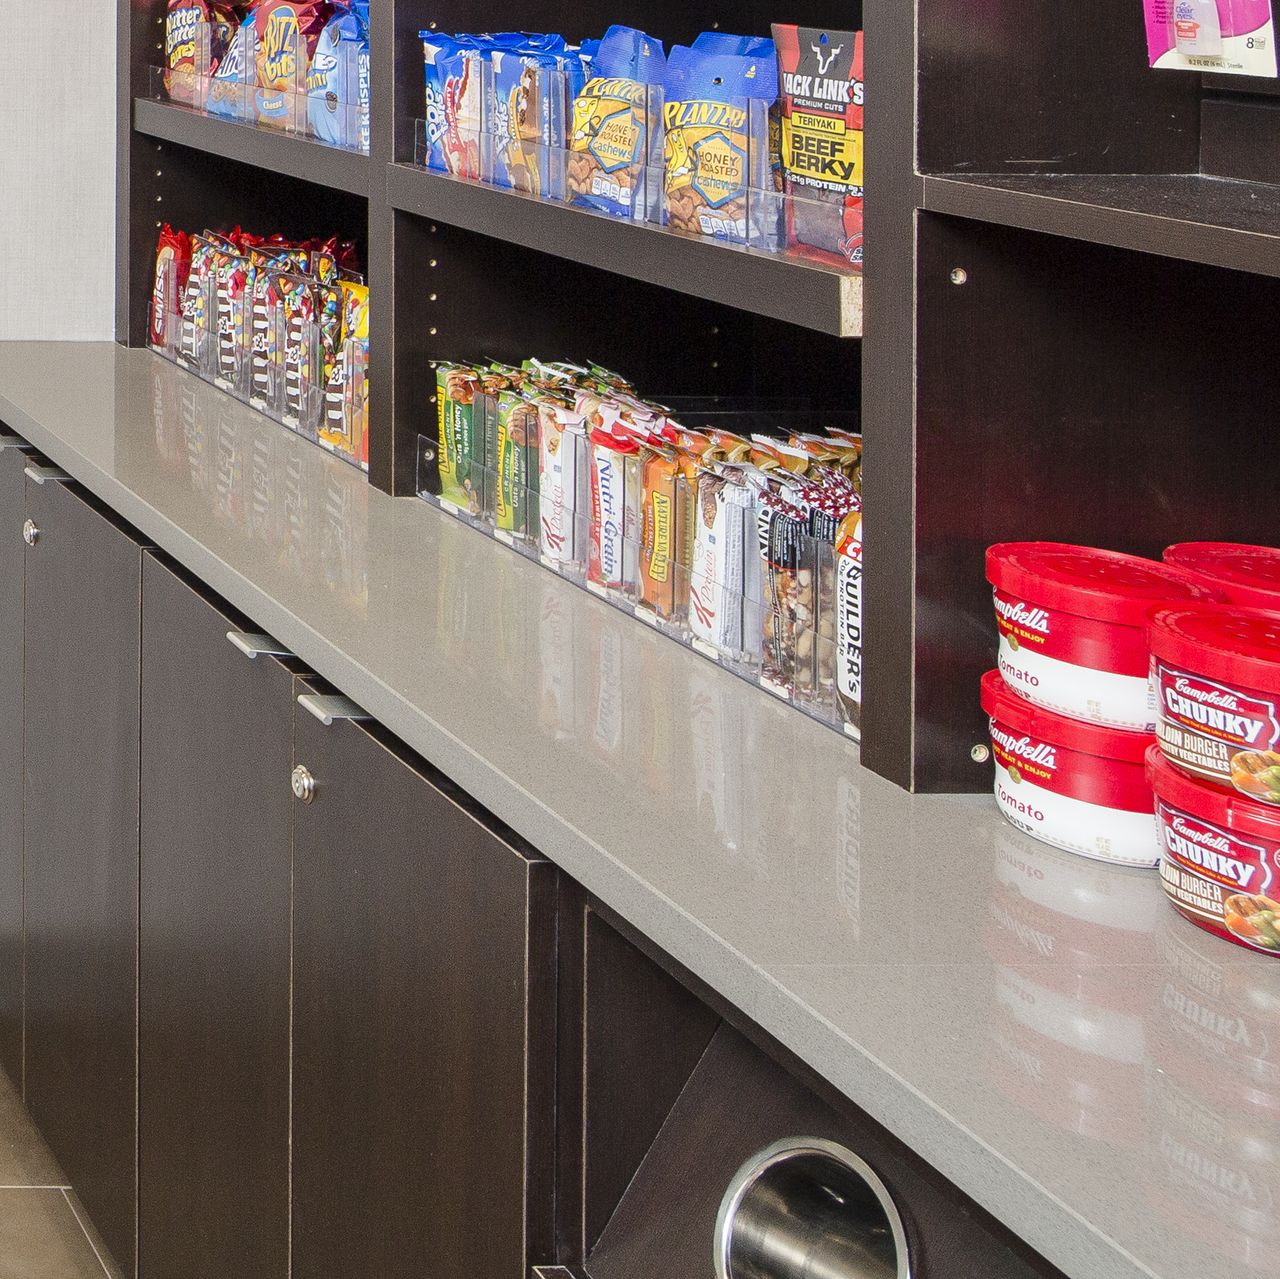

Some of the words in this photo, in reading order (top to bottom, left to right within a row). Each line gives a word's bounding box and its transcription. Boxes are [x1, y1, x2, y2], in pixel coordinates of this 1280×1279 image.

[166, 7, 200, 32] Nutter
[1175, 5, 1194, 15] Clear
[1246, 37, 1255, 49] 8
[793, 97, 823, 111] PREMIUM
[823, 103, 844, 113] CUTS
[814, 77, 864, 105] LINK'S
[604, 121, 636, 137] HONEY
[664, 101, 747, 129] PLANTERS
[797, 115, 836, 132] TERIYAKI
[698, 150, 738, 167] HONEY
[791, 132, 845, 158] BEEF
[700, 164, 739, 178] ROASTED
[789, 150, 855, 181] JERKY
[805, 178, 847, 194] PROTEIN
[454, 403, 463, 431] Honey
[513, 445, 521, 475] Honey
[992, 585, 1050, 634] Campbell's
[845, 565, 863, 695] BUILDER'S
[1019, 629, 1046, 645] ENJOY
[999, 654, 1040, 687] Tomato
[1174, 675, 1239, 712] Campbell's
[1165, 687, 1265, 745] CHUNKY
[988, 716, 1058, 770] Campbell's
[1183, 729, 1229, 761] BURGER
[1024, 764, 1052, 780] ENJOY
[1179, 745, 1231, 773] VEGETABLES
[997, 783, 1045, 821] Tomato
[1171, 816, 1232, 856] Campbell's
[1164, 824, 1256, 888] CHUNKY
[1180, 870, 1223, 902] BURGER
[1176, 887, 1225, 916] VEGETABLES
